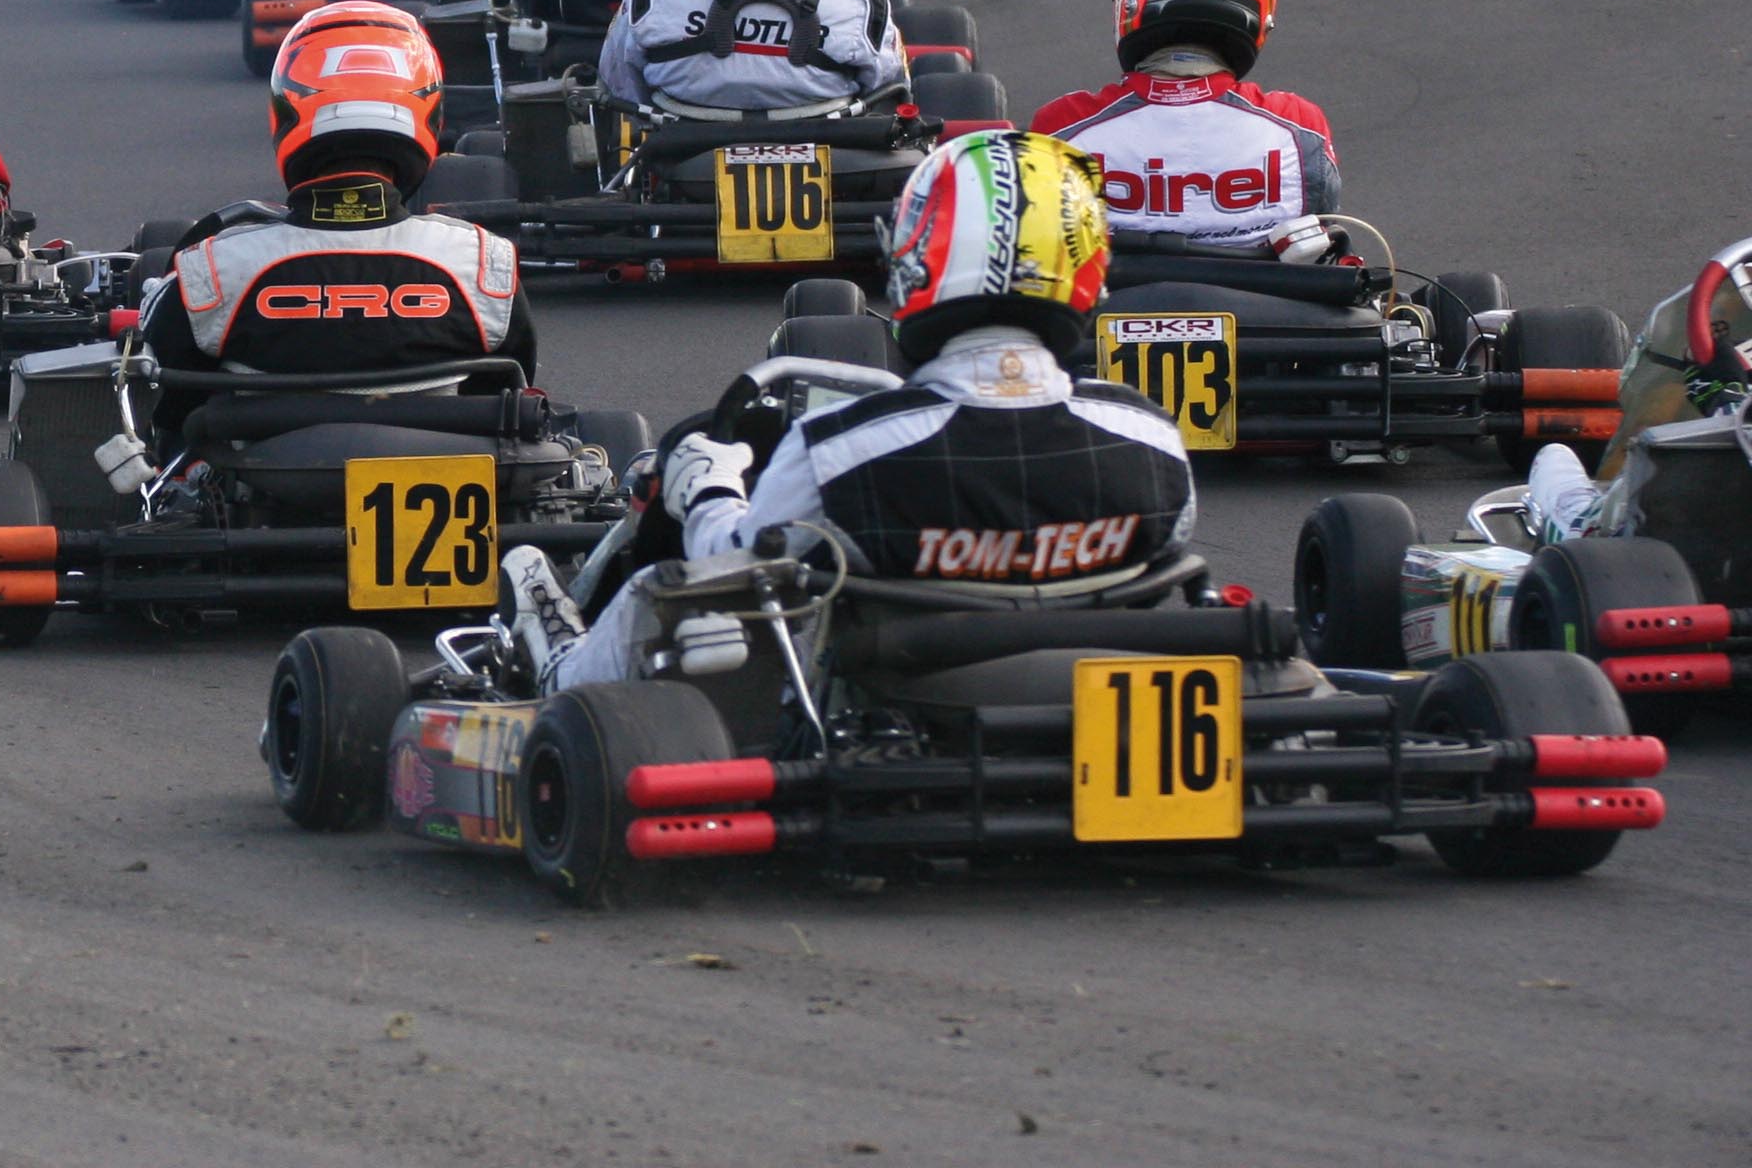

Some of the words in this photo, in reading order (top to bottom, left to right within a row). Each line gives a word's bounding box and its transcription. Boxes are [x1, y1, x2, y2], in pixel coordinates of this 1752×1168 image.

[725, 159, 823, 232] 106
[1091, 149, 1282, 218] birel
[256, 284, 451, 319] CRG
[1110, 342, 1232, 430] 103
[363, 482, 491, 587] 123
[915, 514, 1140, 579] TOM-TECH
[1107, 669, 1219, 797] 116
